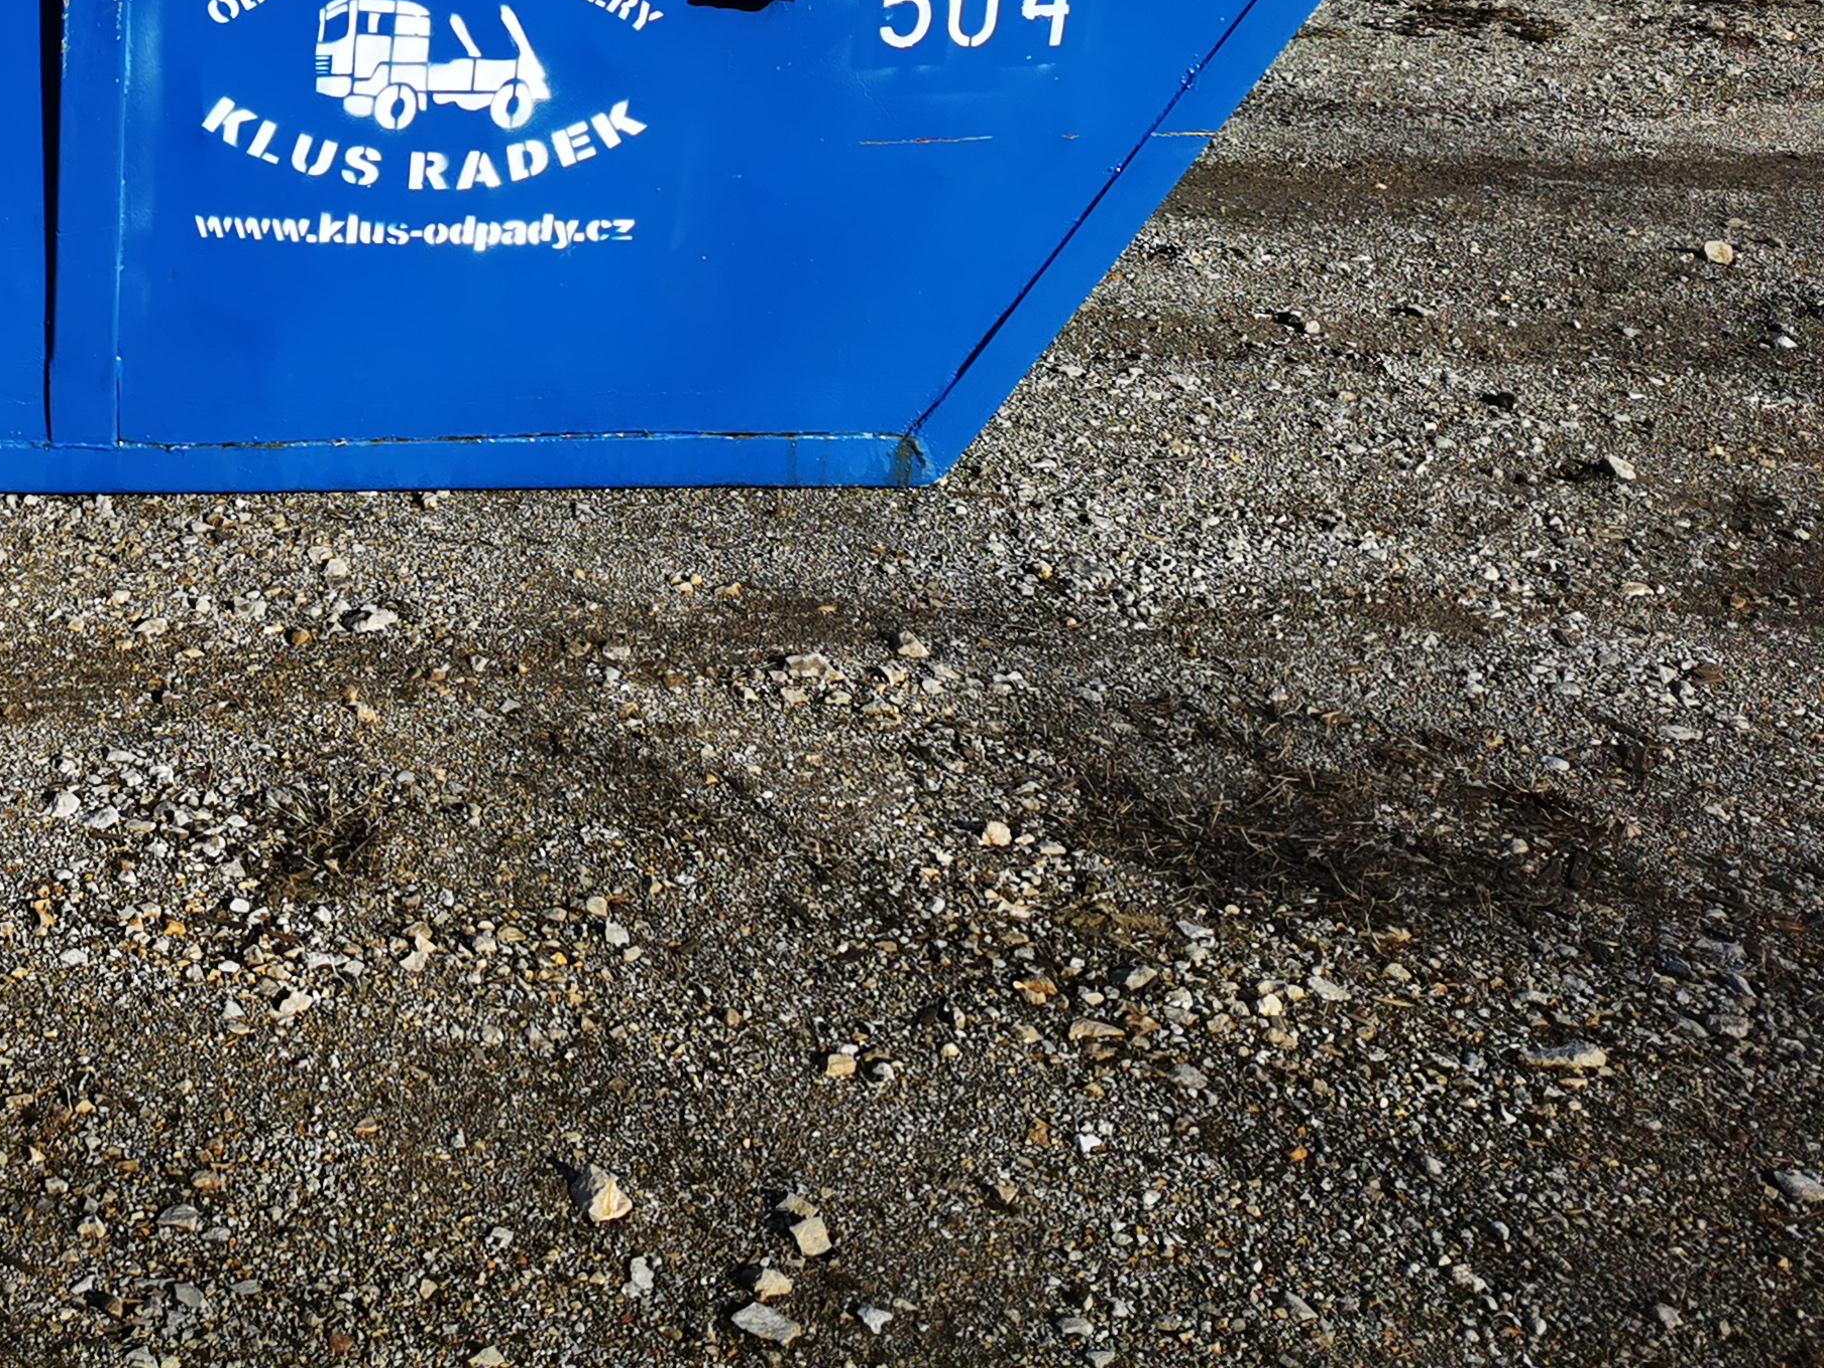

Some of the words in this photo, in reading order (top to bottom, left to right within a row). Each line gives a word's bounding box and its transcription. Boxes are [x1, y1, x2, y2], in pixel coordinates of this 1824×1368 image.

[202, 95, 382, 188] KLUS
[407, 101, 648, 191] RADEK
[194, 212, 636, 252] www.klus-odpady.cz
